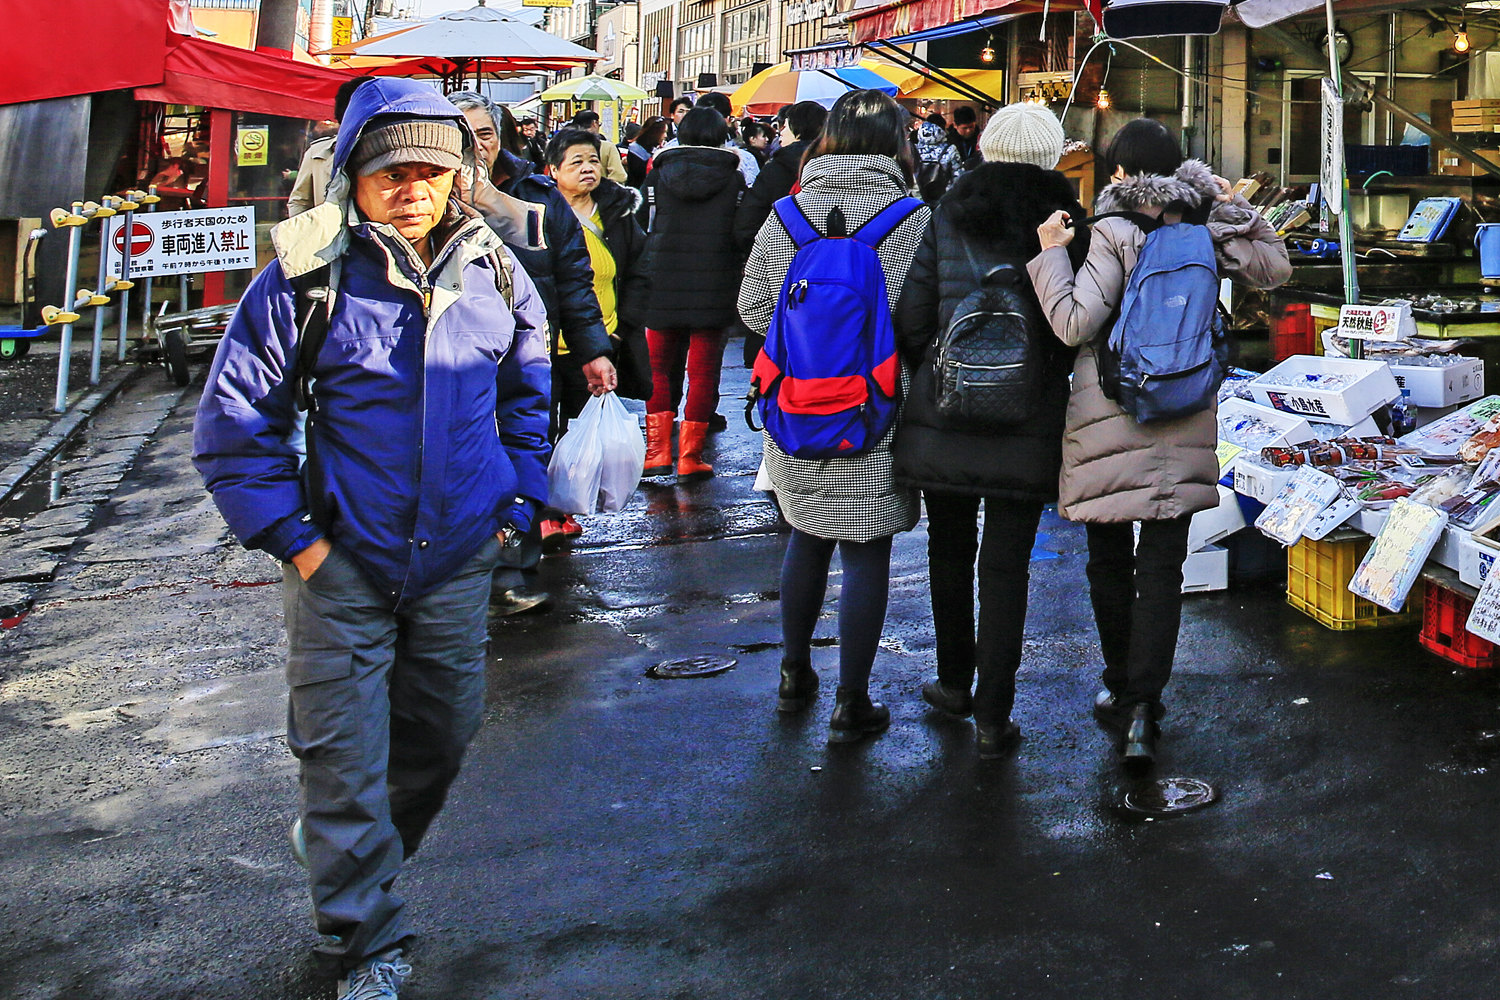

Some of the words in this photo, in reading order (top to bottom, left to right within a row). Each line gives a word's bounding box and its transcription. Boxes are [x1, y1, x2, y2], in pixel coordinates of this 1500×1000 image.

[162, 215, 248, 229] 歩行者天国のため
[162, 230, 249, 256] 車両進入禁止
[162, 257, 250, 269] 午前7時から午後1時まで
[1342, 316, 1373, 330] 天然秋鮭
